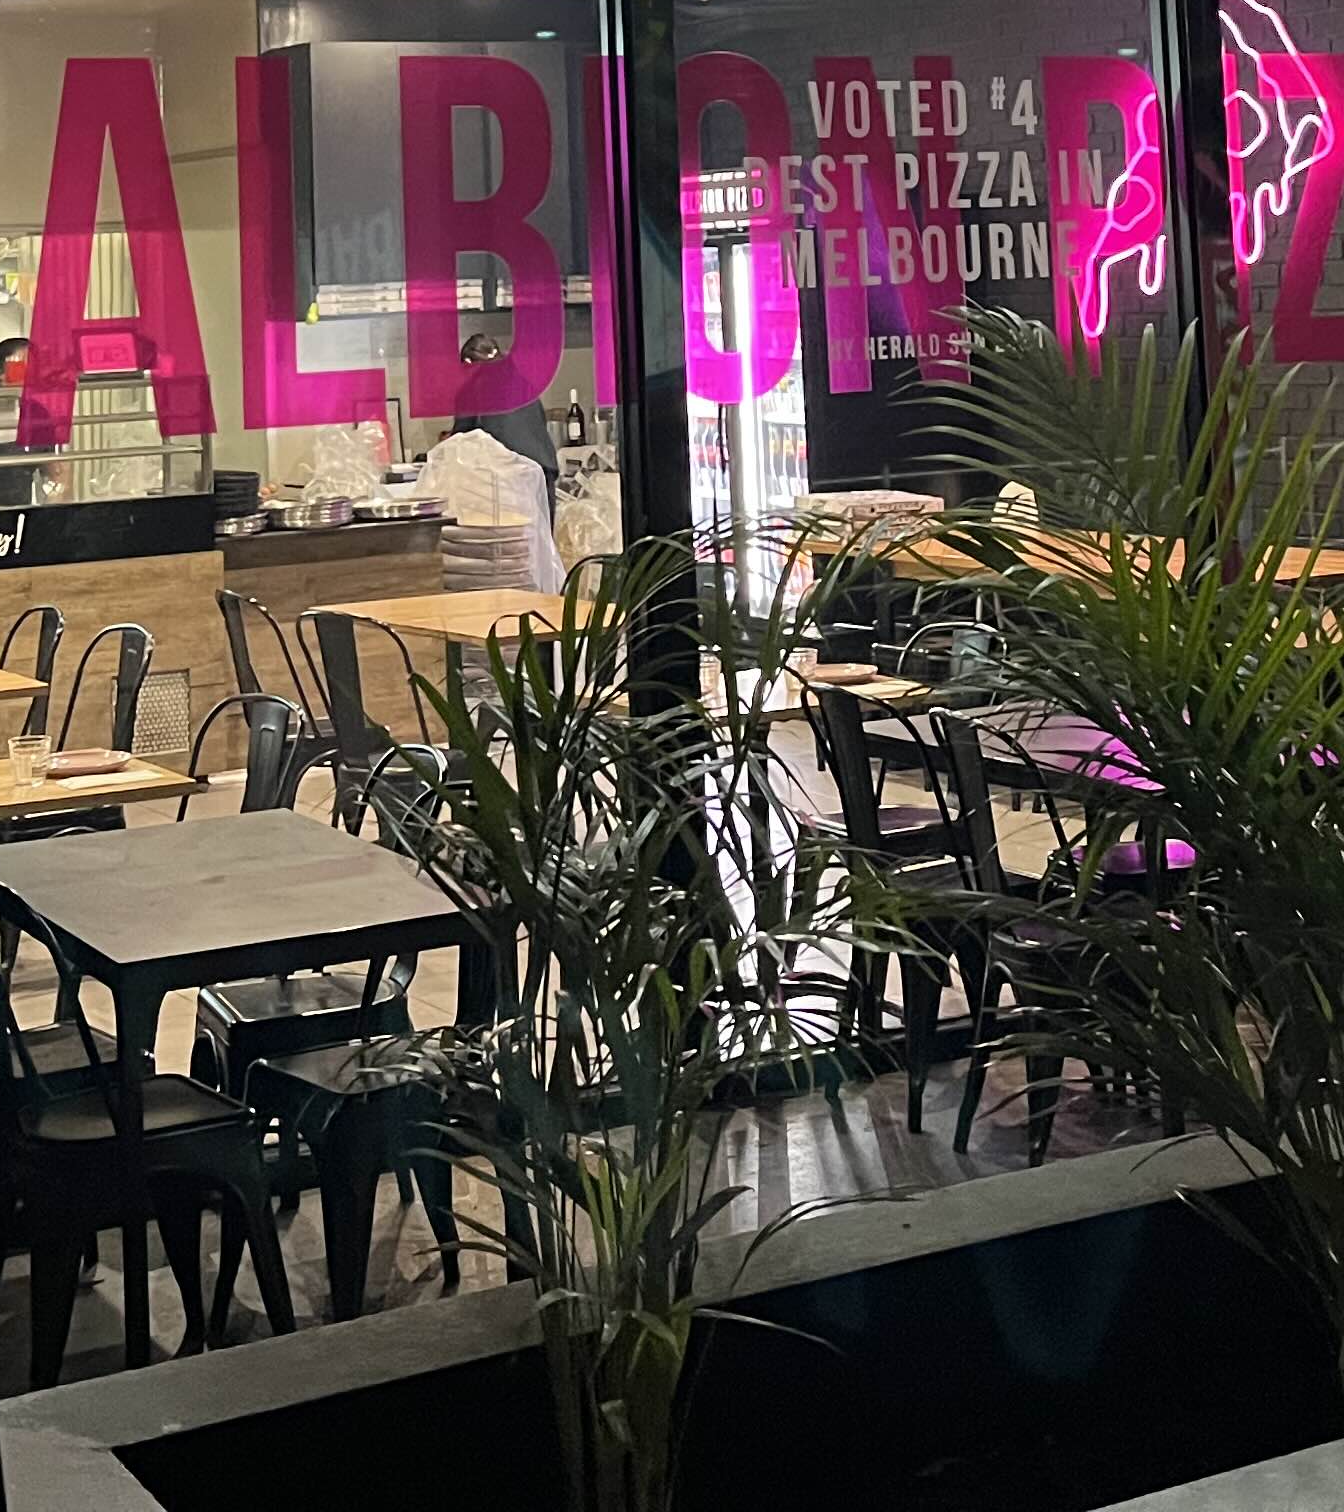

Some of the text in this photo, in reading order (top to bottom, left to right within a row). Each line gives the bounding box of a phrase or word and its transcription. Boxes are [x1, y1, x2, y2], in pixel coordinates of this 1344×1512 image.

[807, 76, 1038, 138] VOTED #4
[743, 149, 1104, 216] BEST PIZZA IN
[17, 50, 972, 445] ALBION
[779, 220, 1080, 288] MELBOURNE
[867, 334, 940, 360] HERALD
